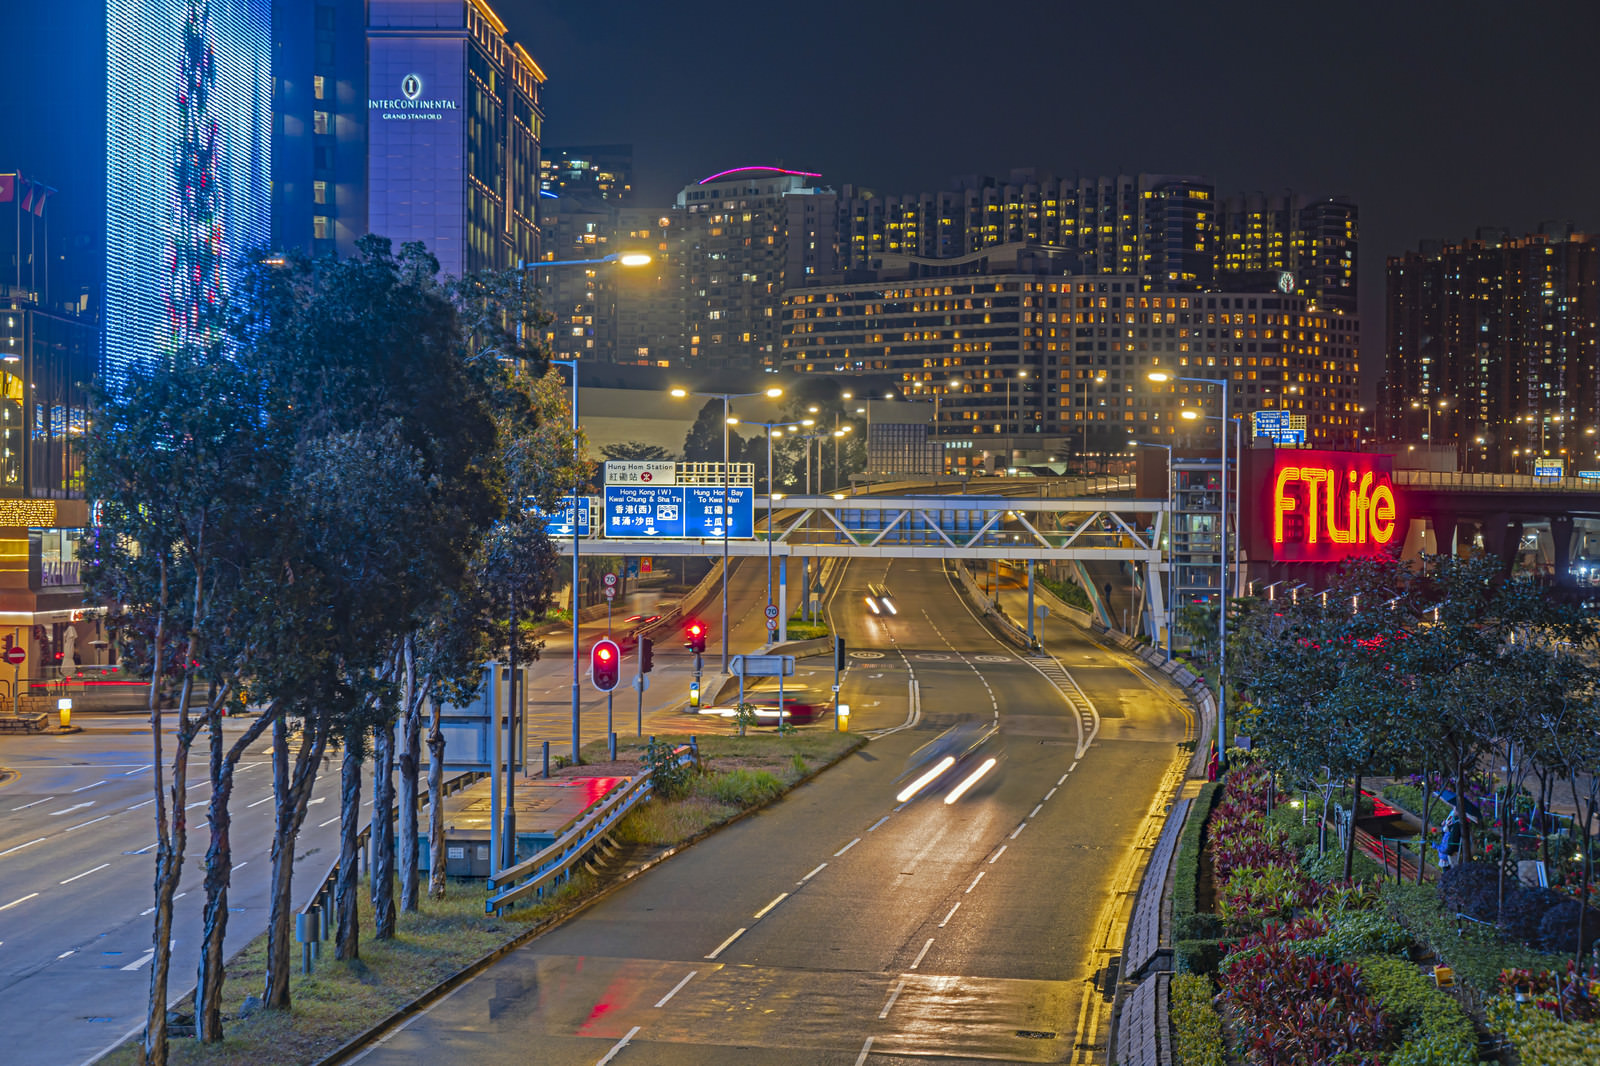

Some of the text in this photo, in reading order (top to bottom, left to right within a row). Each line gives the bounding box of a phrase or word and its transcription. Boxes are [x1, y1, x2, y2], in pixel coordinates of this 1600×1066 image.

[608, 463, 626, 471] Hung
[609, 472, 638, 481] 紅磡站
[693, 489, 710, 497] Hung
[731, 489, 744, 498] Bay
[626, 495, 647, 503] Chung
[615, 504, 652, 514] 香港(西)
[1274, 467, 1396, 544] FTLife
